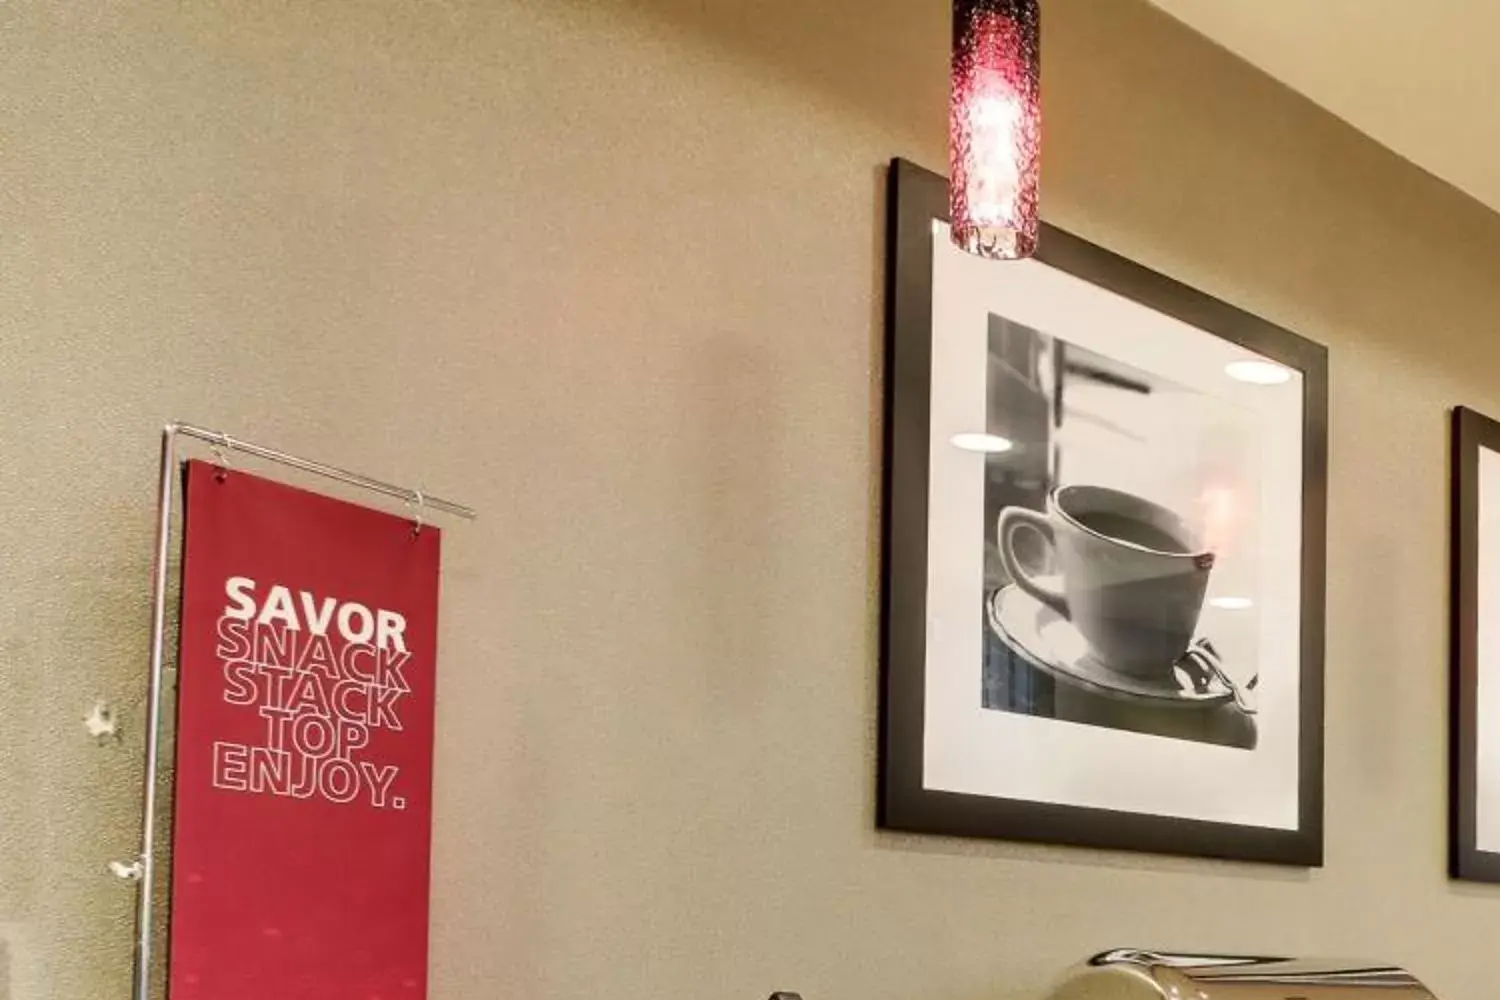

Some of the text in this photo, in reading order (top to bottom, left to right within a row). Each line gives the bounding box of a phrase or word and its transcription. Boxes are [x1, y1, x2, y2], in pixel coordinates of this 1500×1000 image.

[224, 576, 406, 652] SAVOR
[216, 615, 411, 694] SNACK
[222, 658, 403, 730] STACK
[260, 706, 369, 761] TOP
[212, 741, 406, 809] ENJOY.
